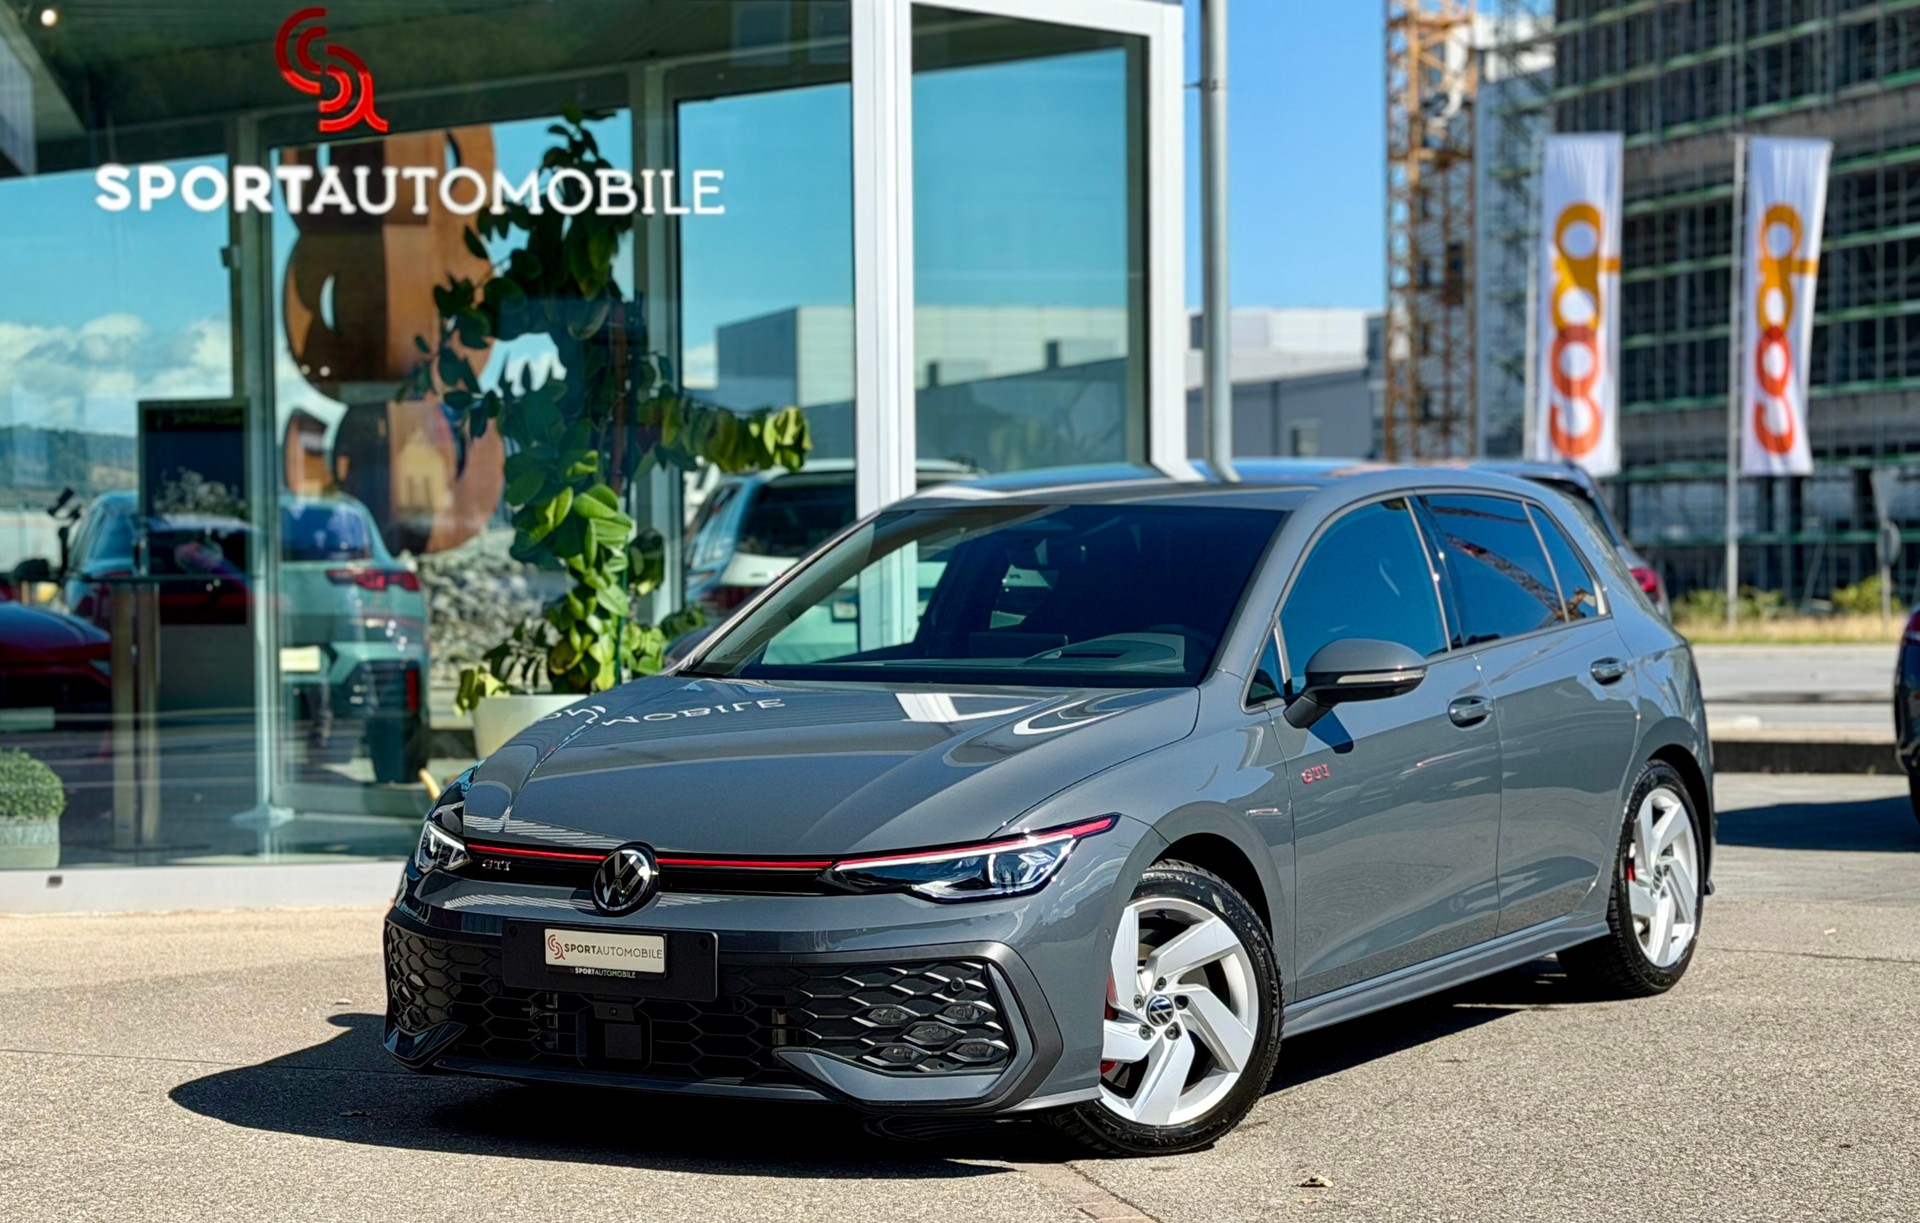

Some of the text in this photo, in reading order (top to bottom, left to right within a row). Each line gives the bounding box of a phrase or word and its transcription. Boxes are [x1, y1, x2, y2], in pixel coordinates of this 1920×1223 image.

[95, 163, 726, 216] SPORTAUTOMOBILE
[1301, 763, 1331, 784] GTI
[482, 858, 512, 871] GTI
[563, 942, 664, 960] SPORTAUTOMOBILE
[574, 966, 637, 979] SPORTAUTOMOBILE
